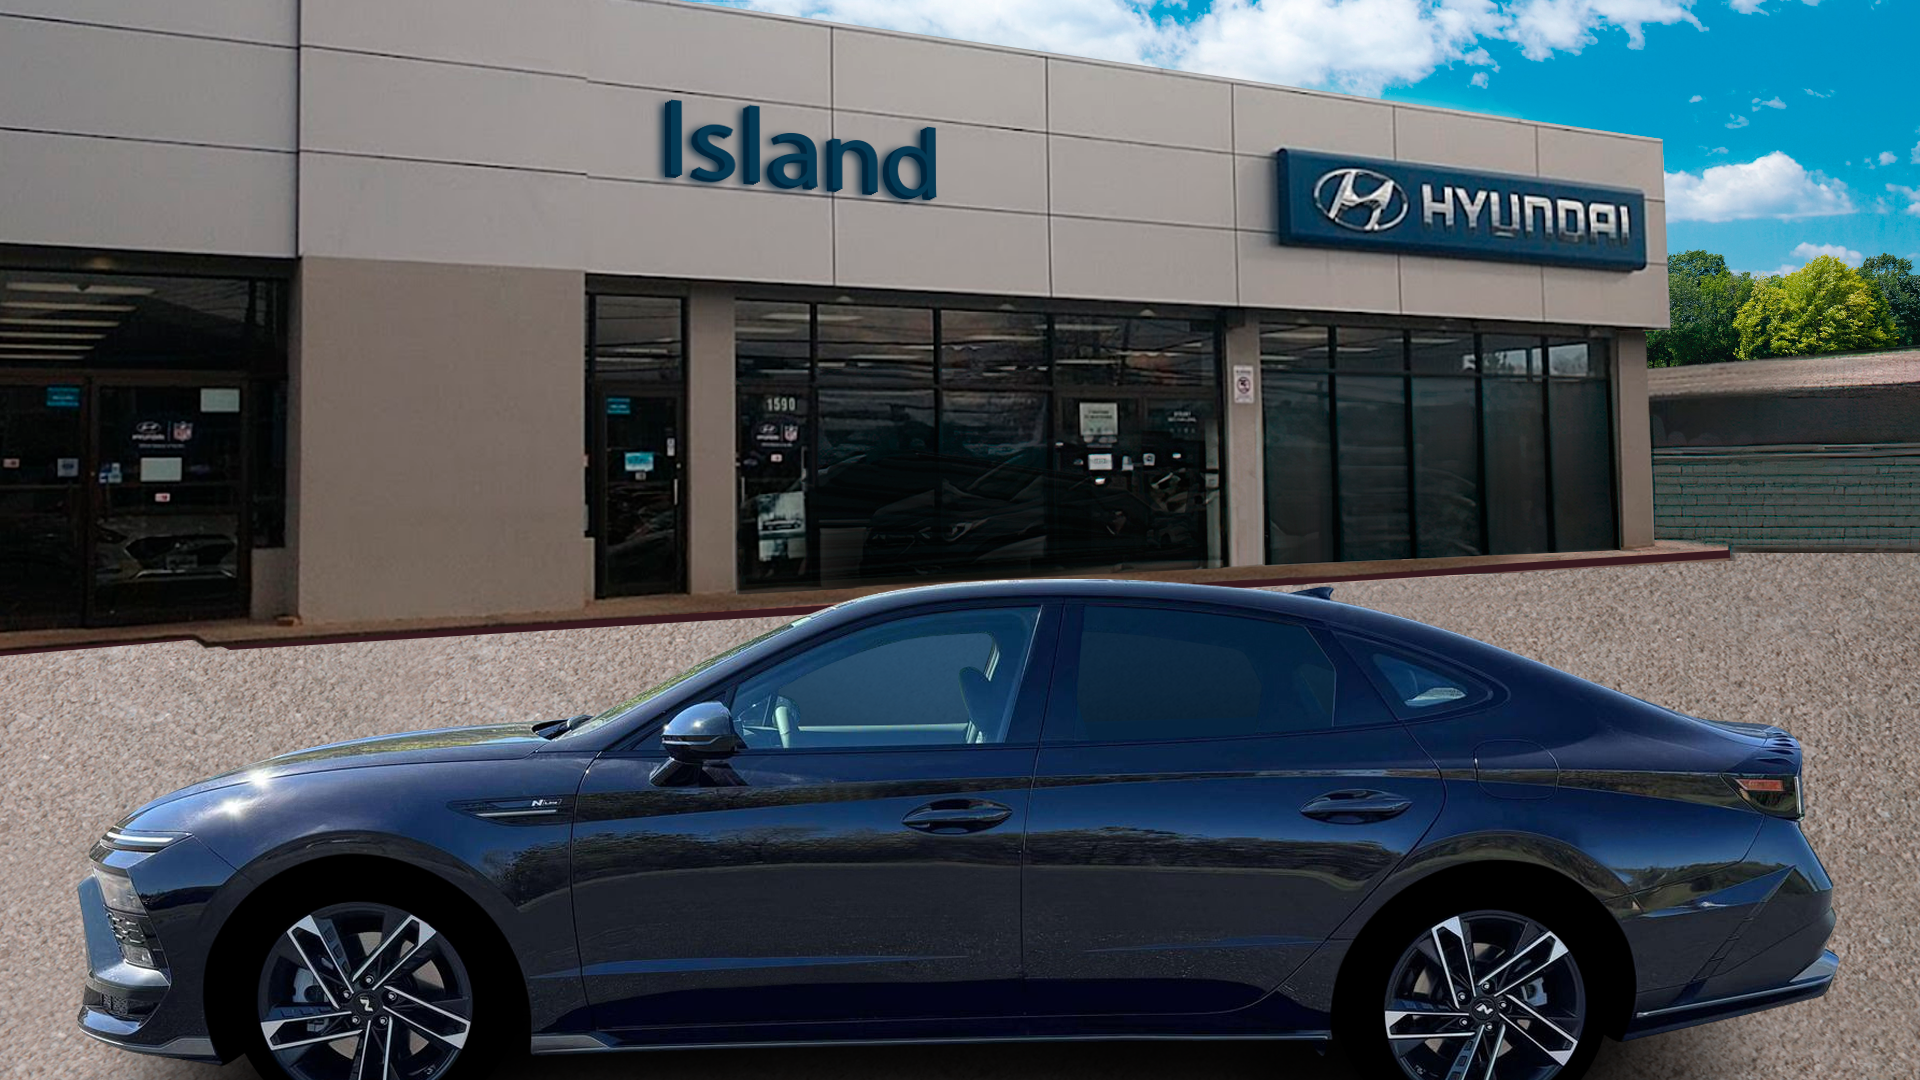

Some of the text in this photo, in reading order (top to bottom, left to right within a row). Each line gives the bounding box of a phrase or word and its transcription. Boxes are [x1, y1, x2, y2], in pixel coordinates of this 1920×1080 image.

[664, 99, 937, 201] Island
[1421, 184, 1630, 246] HYUNDAI
[766, 397, 796, 412] 1590
